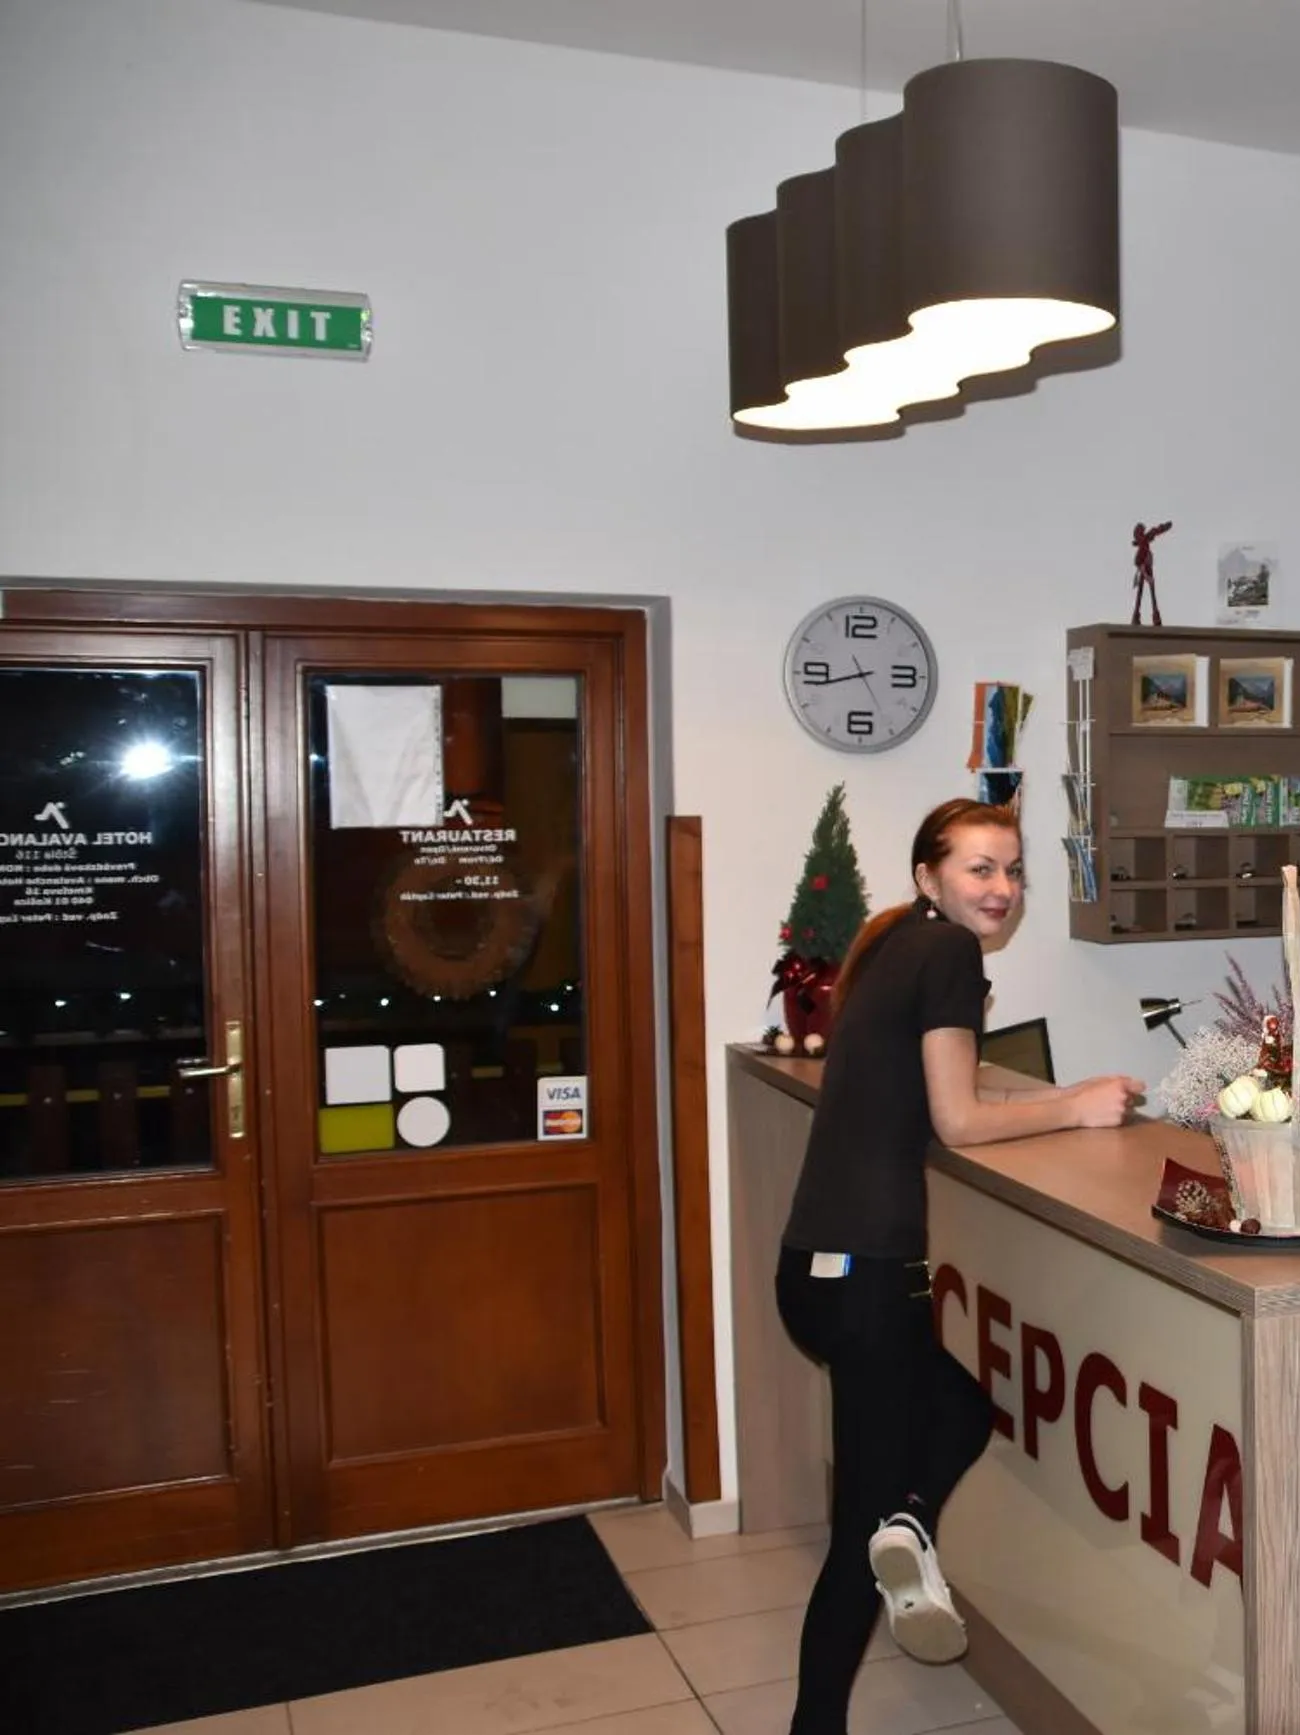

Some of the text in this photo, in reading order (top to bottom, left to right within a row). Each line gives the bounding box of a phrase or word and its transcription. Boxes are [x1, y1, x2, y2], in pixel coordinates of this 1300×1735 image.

[222, 304, 331, 341] EXIT
[845, 615, 878, 638] 12
[803, 661, 917, 688] 9 3
[847, 711, 873, 735] 6
[546, 1086, 581, 1101] VISA
